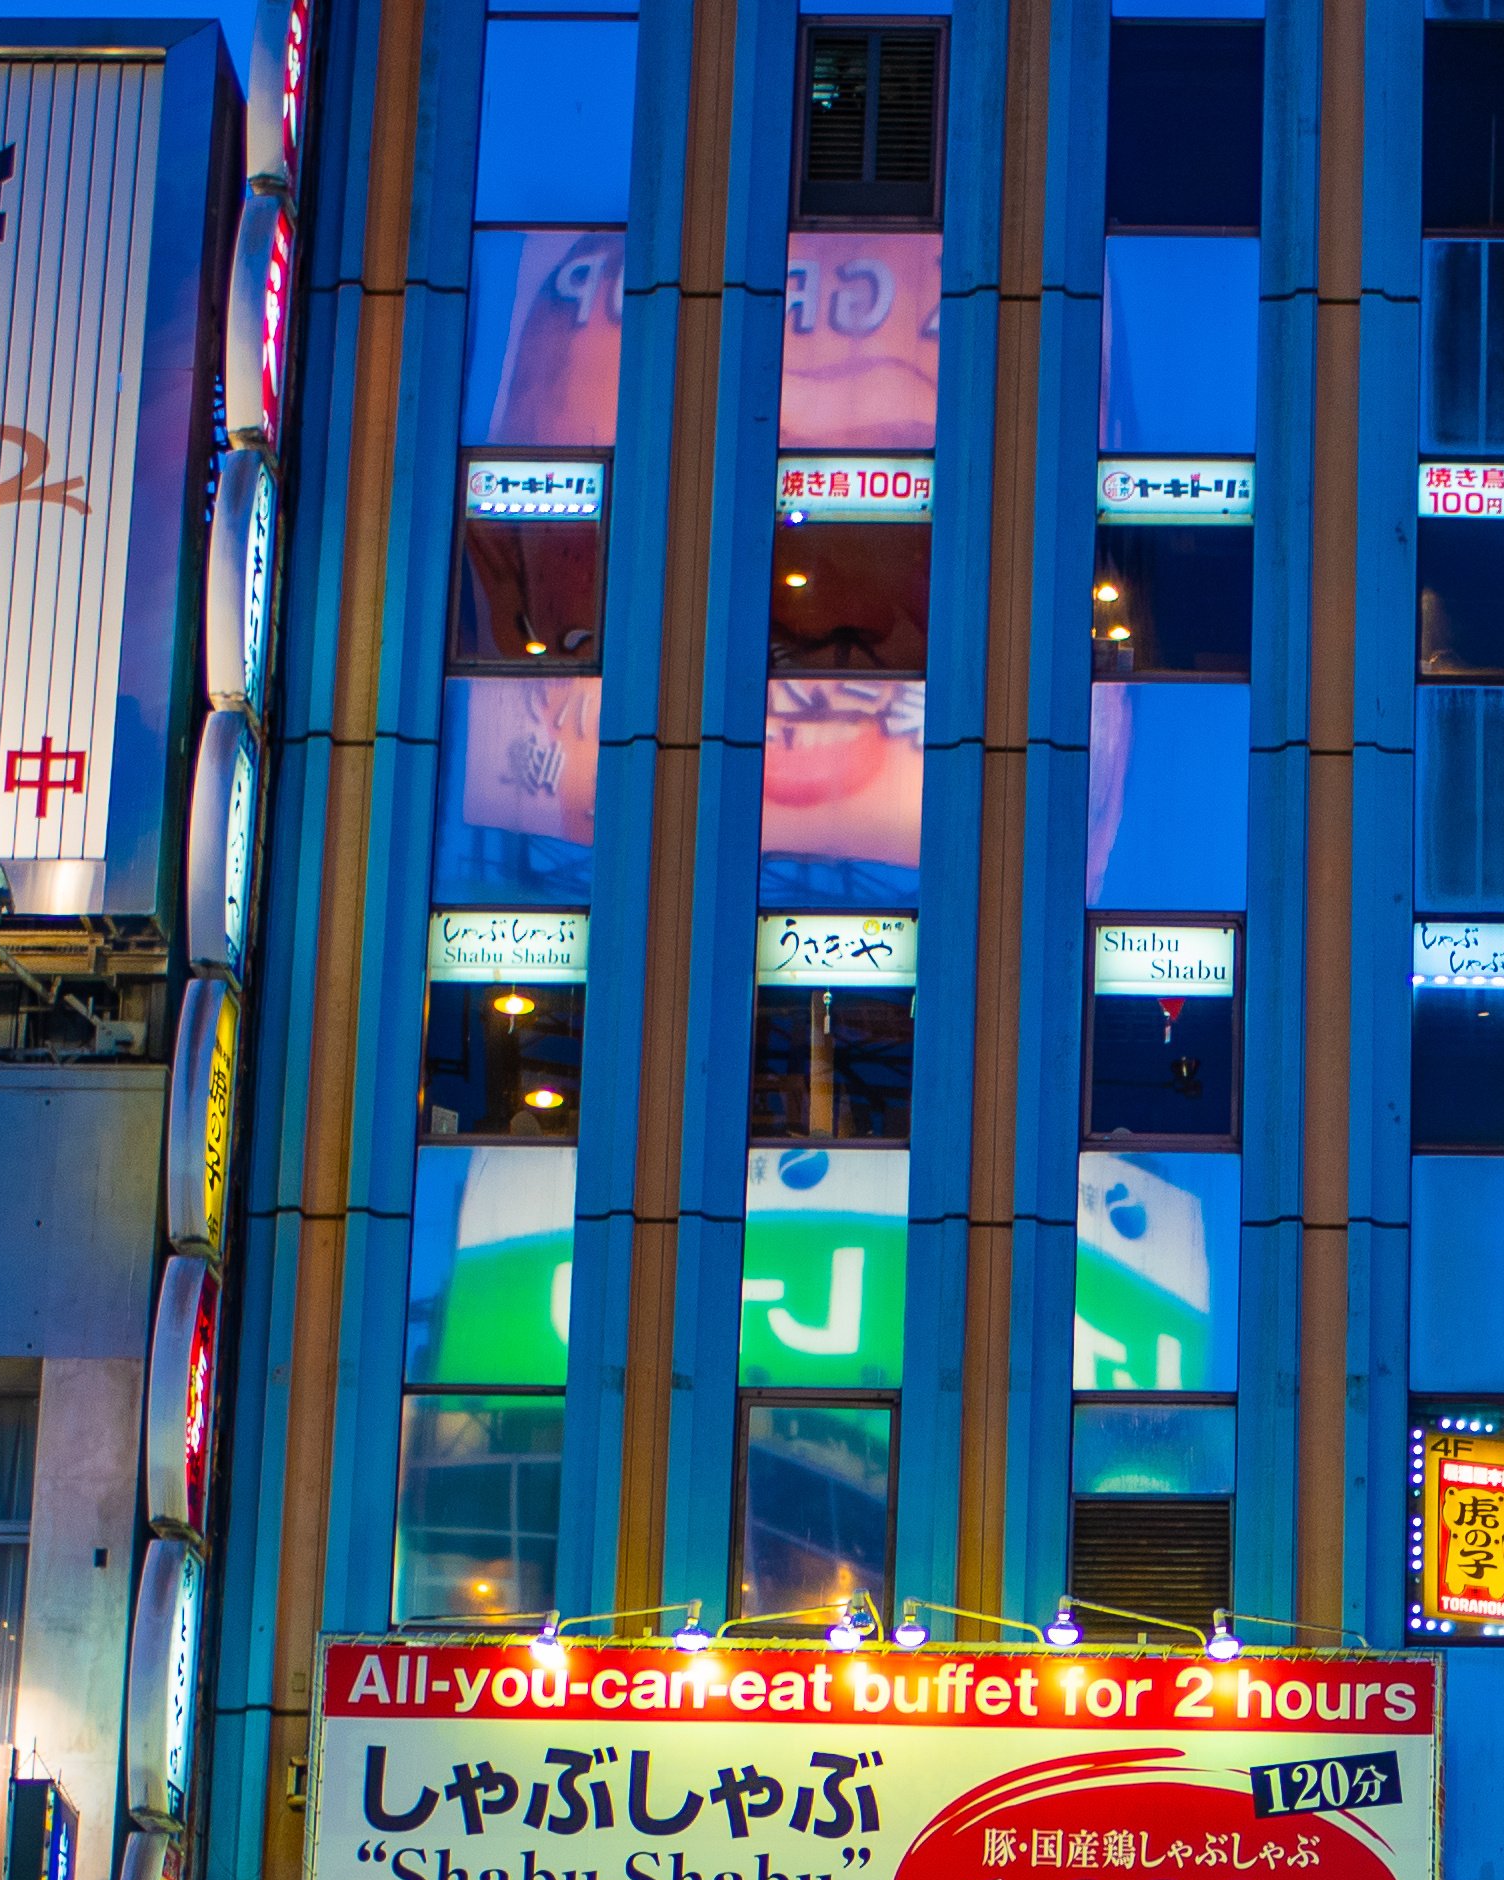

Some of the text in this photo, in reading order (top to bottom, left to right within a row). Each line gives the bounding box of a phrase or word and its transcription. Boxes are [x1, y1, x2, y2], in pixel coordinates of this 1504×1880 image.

[782, 470, 931, 499] 焼き鳥 100円
[1430, 492, 1502, 515] 100円
[444, 945, 571, 966] Shabu Shabu
[1103, 931, 1181, 954] Shabu
[1150, 959, 1227, 982] Shabu
[1430, 1437, 1474, 1458] 4F
[1453, 1496, 1501, 1579] 虎の子
[348, 1652, 1418, 1724] All-you-can-eat buffet for 2 hours
[361, 1745, 885, 1839] しゃぶしゃぶ
[1262, 1760, 1388, 1816] 120分
[983, 1827, 1320, 1872] 豚・国産鶏しゃぶしゃぶ
